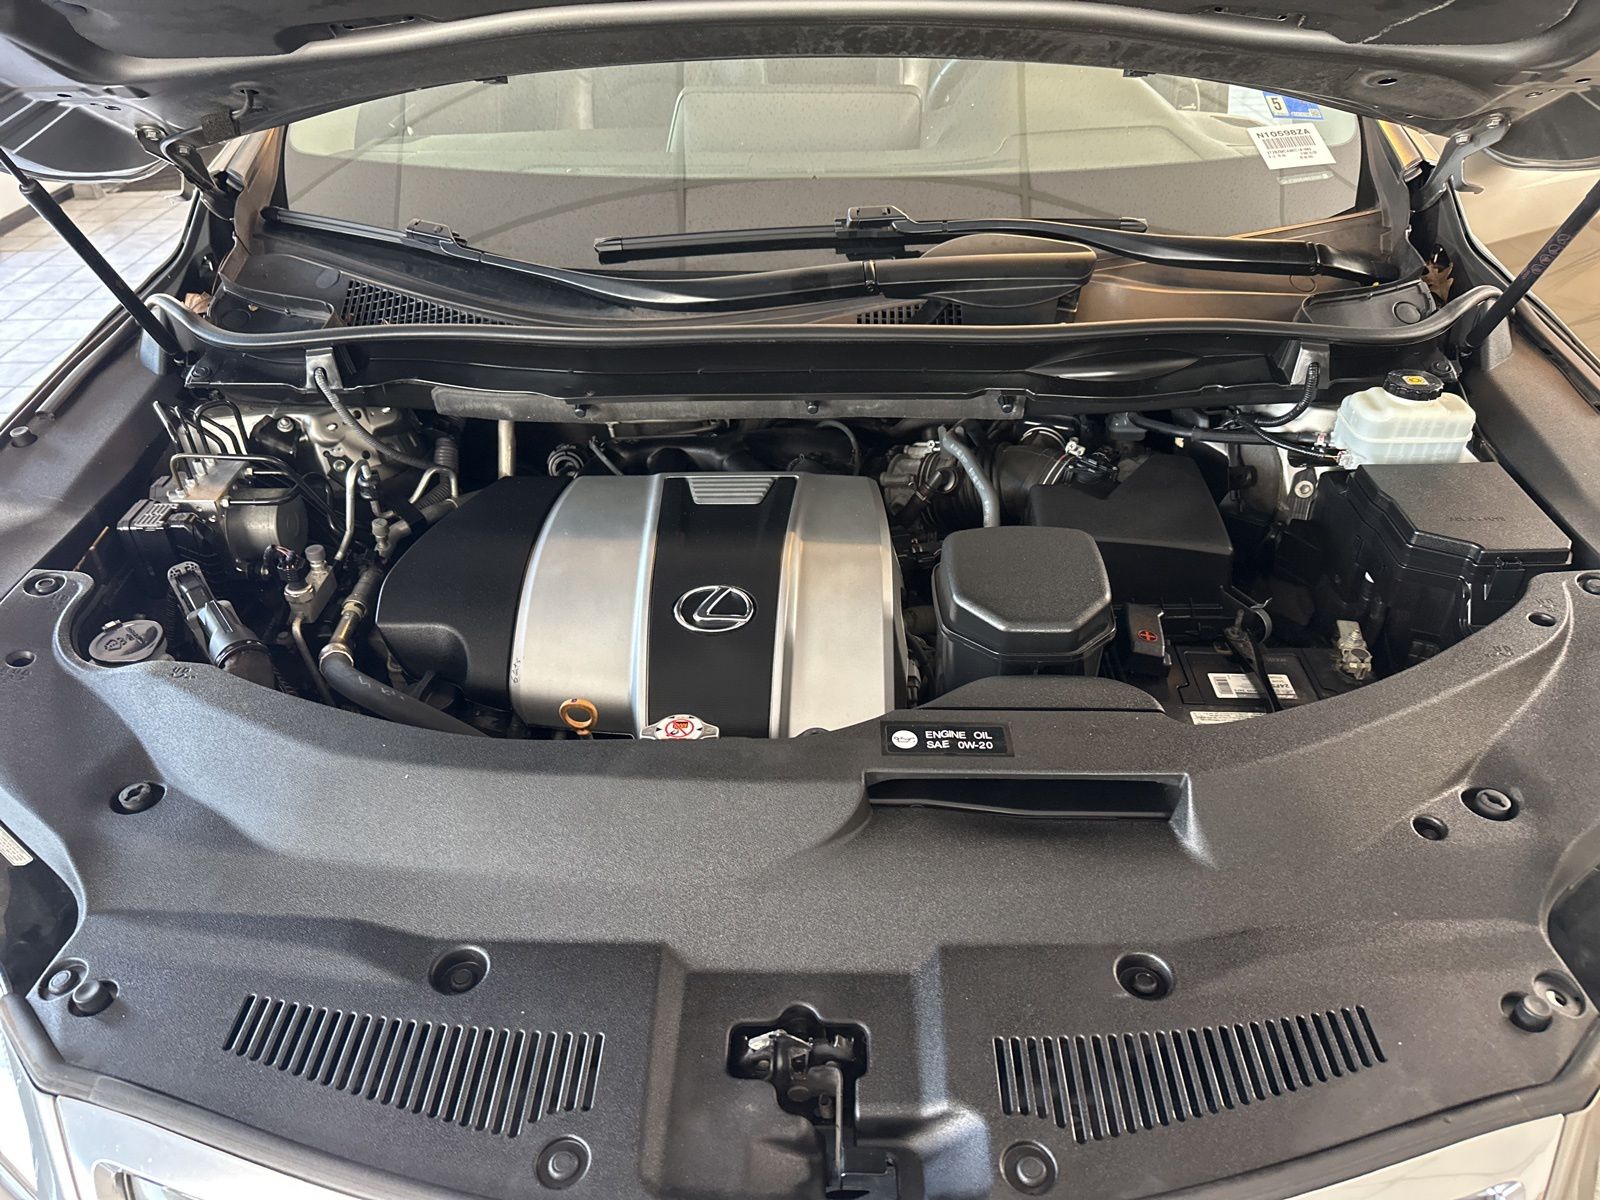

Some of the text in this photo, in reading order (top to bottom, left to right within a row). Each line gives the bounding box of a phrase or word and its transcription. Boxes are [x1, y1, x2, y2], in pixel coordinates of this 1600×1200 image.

[1271, 97, 1282, 111] 5
[1256, 128, 1311, 139] N10598ZA
[925, 730, 993, 740] ENGINE OIL
[926, 740, 994, 750] SAE 0W-20
